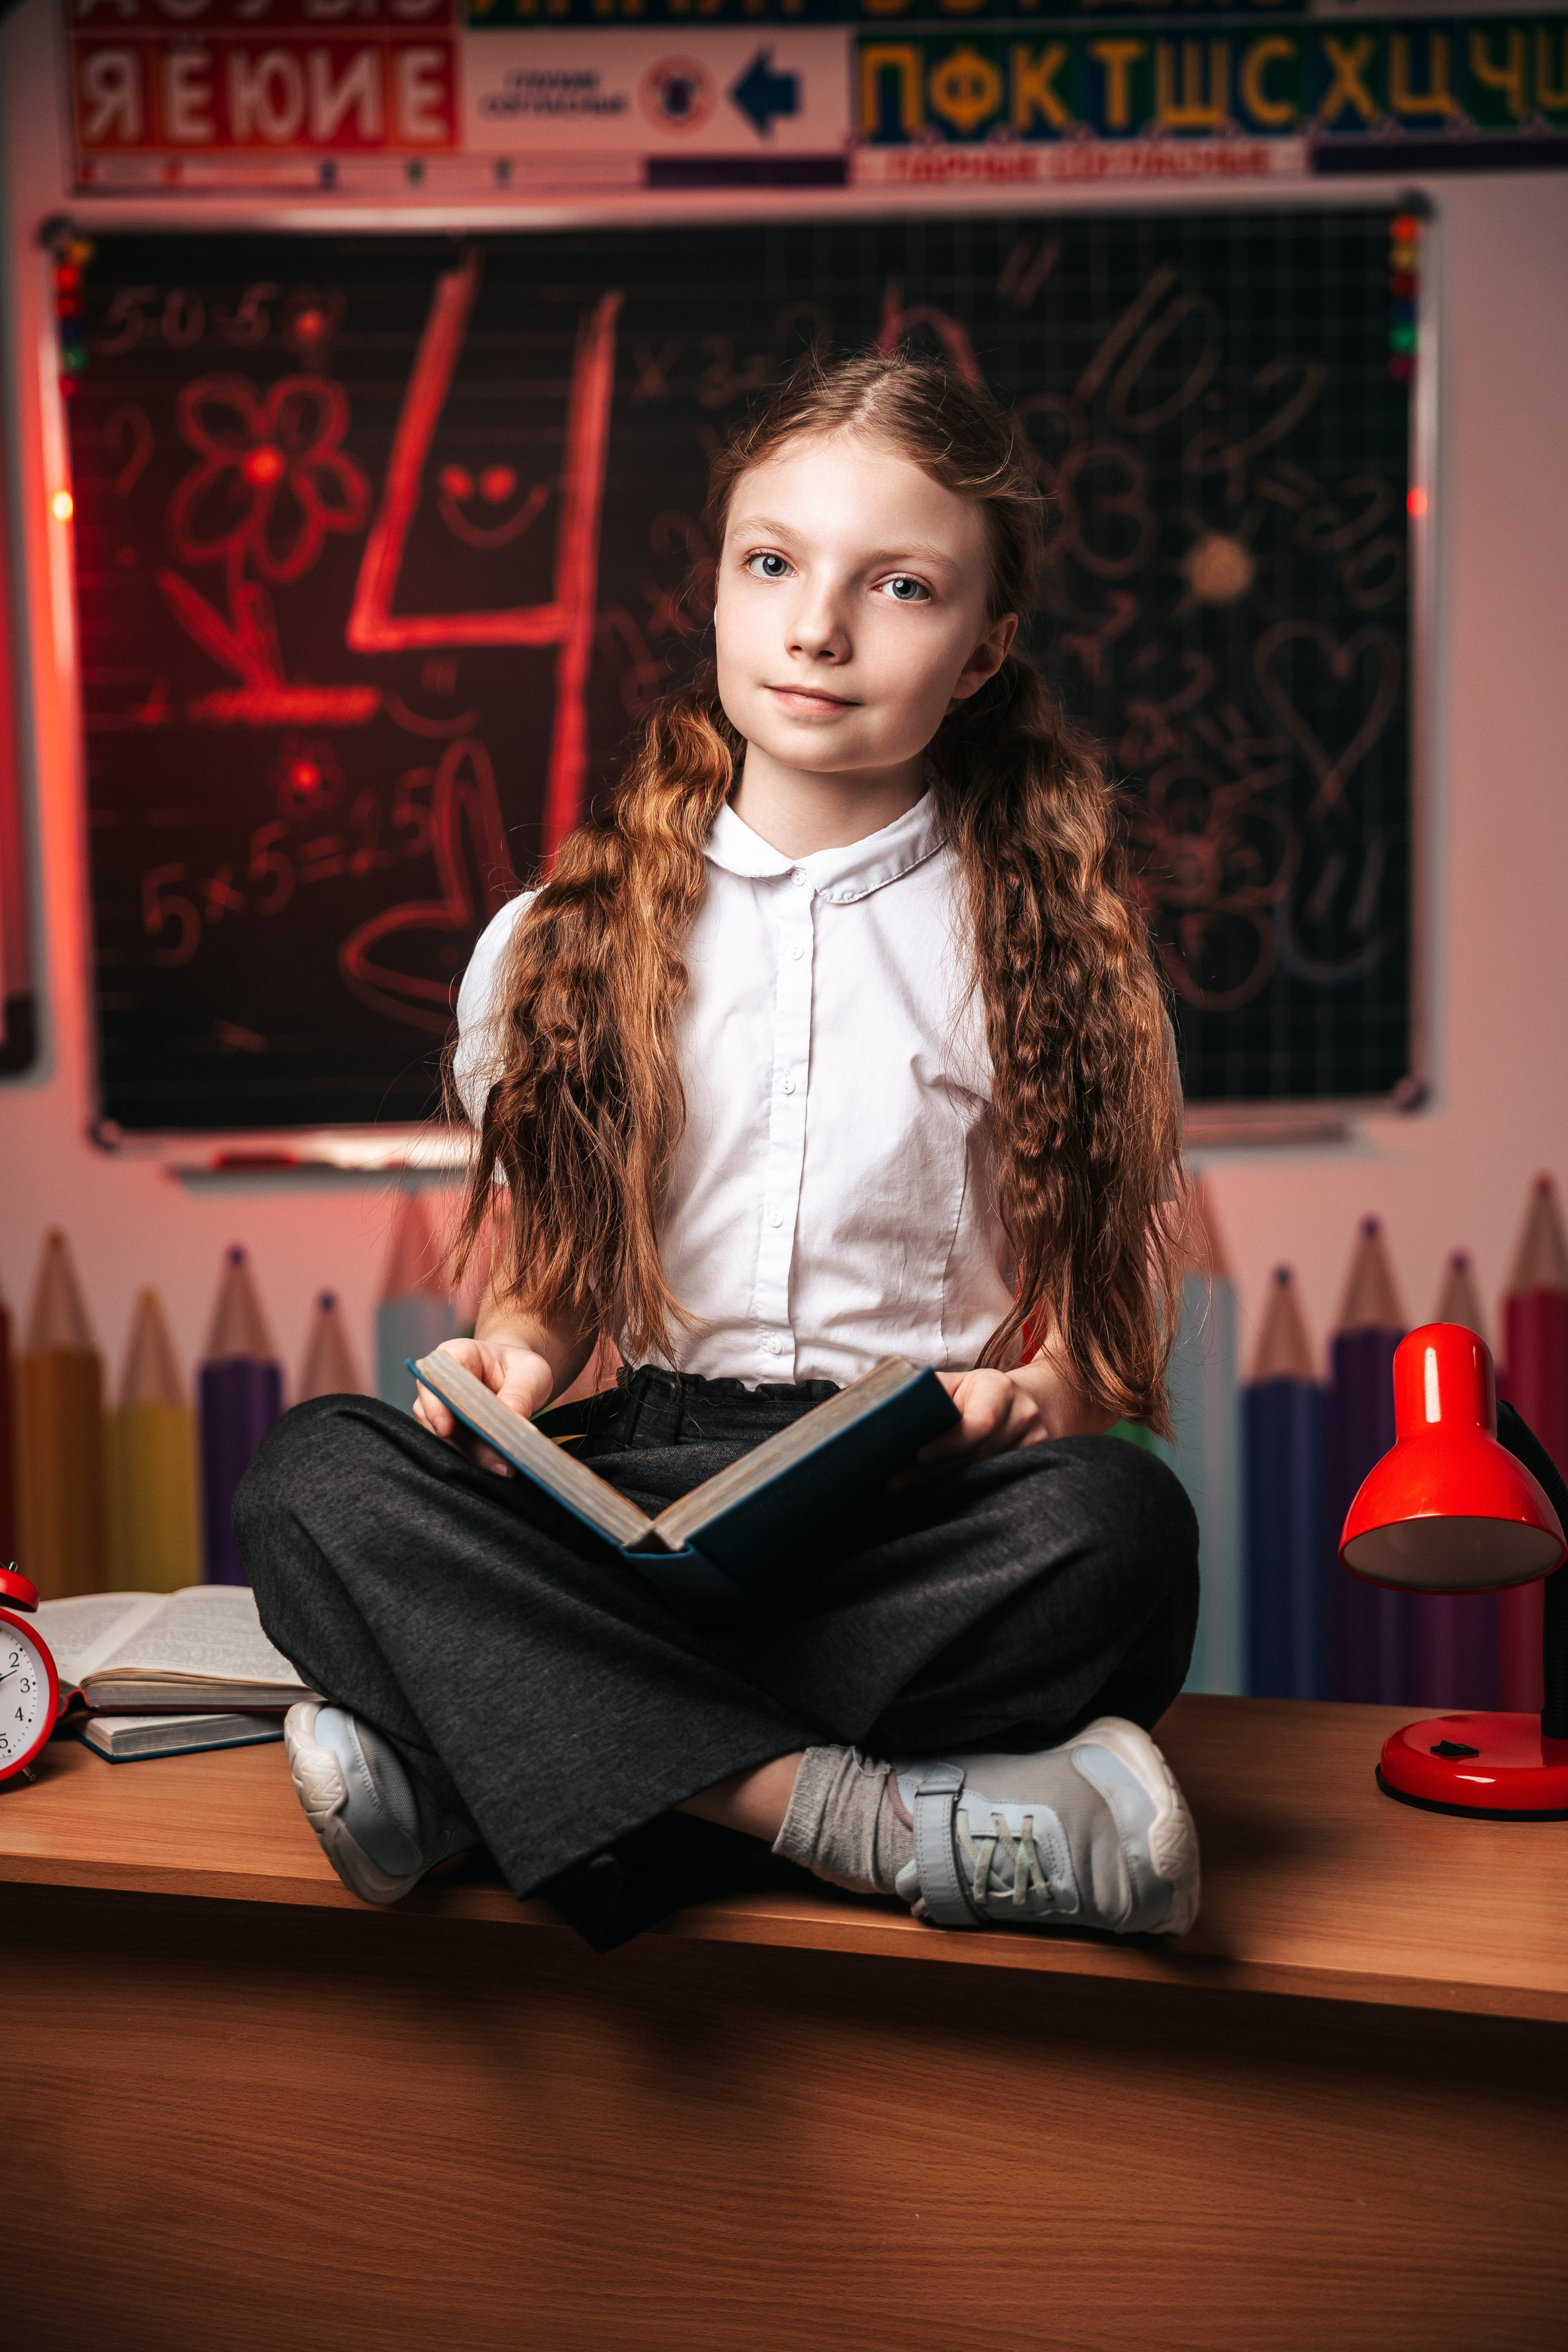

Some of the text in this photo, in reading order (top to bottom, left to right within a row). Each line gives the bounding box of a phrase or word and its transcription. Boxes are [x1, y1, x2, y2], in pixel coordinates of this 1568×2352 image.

[9, 1652, 20, 1668] 2
[20, 1678, 31, 1693] 3
[14, 1706, 24, 1721] 4
